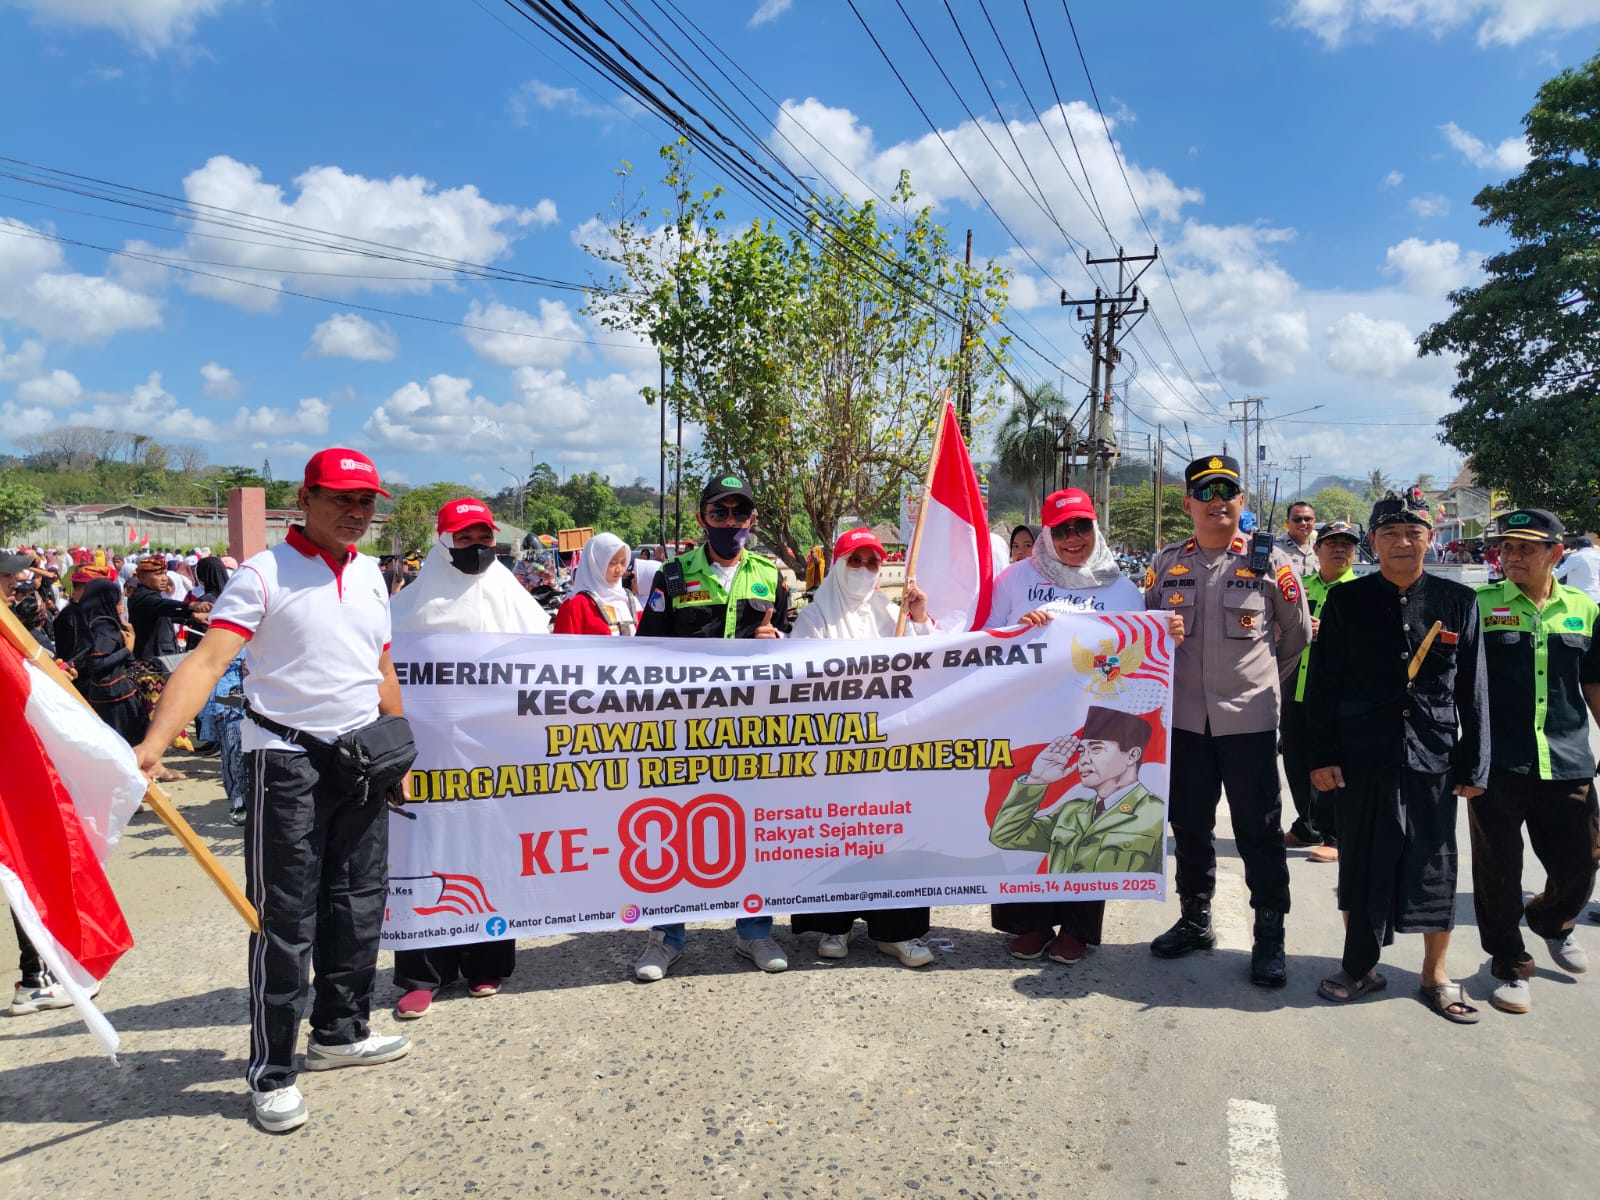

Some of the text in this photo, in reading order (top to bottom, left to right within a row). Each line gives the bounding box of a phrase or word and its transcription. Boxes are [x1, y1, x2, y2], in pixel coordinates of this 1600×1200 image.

[1226, 579, 1265, 591] POLRI
[393, 642, 1048, 686] EMERINTAH KABUPATEN LOMBOK BARAT
[516, 674, 914, 717] KECAMATAN LEMBAR
[545, 711, 888, 758] PAWAI KARNAVAL
[409, 738, 1015, 803] DIRGAHAYU REPUBLIK INDONESIA
[753, 800, 912, 822] Bersatu Berdaulat
[753, 820, 904, 846] Rakyat Sejahtera
[754, 841, 885, 863] Indonesia Maju
[944, 884, 988, 896] CHANNEL
[999, 877, 1157, 895] Kamis,14 Agustus 2025
[641, 898, 740, 917] KantorCamatLembar
[508, 910, 616, 928] Kantor Camat Lembar
